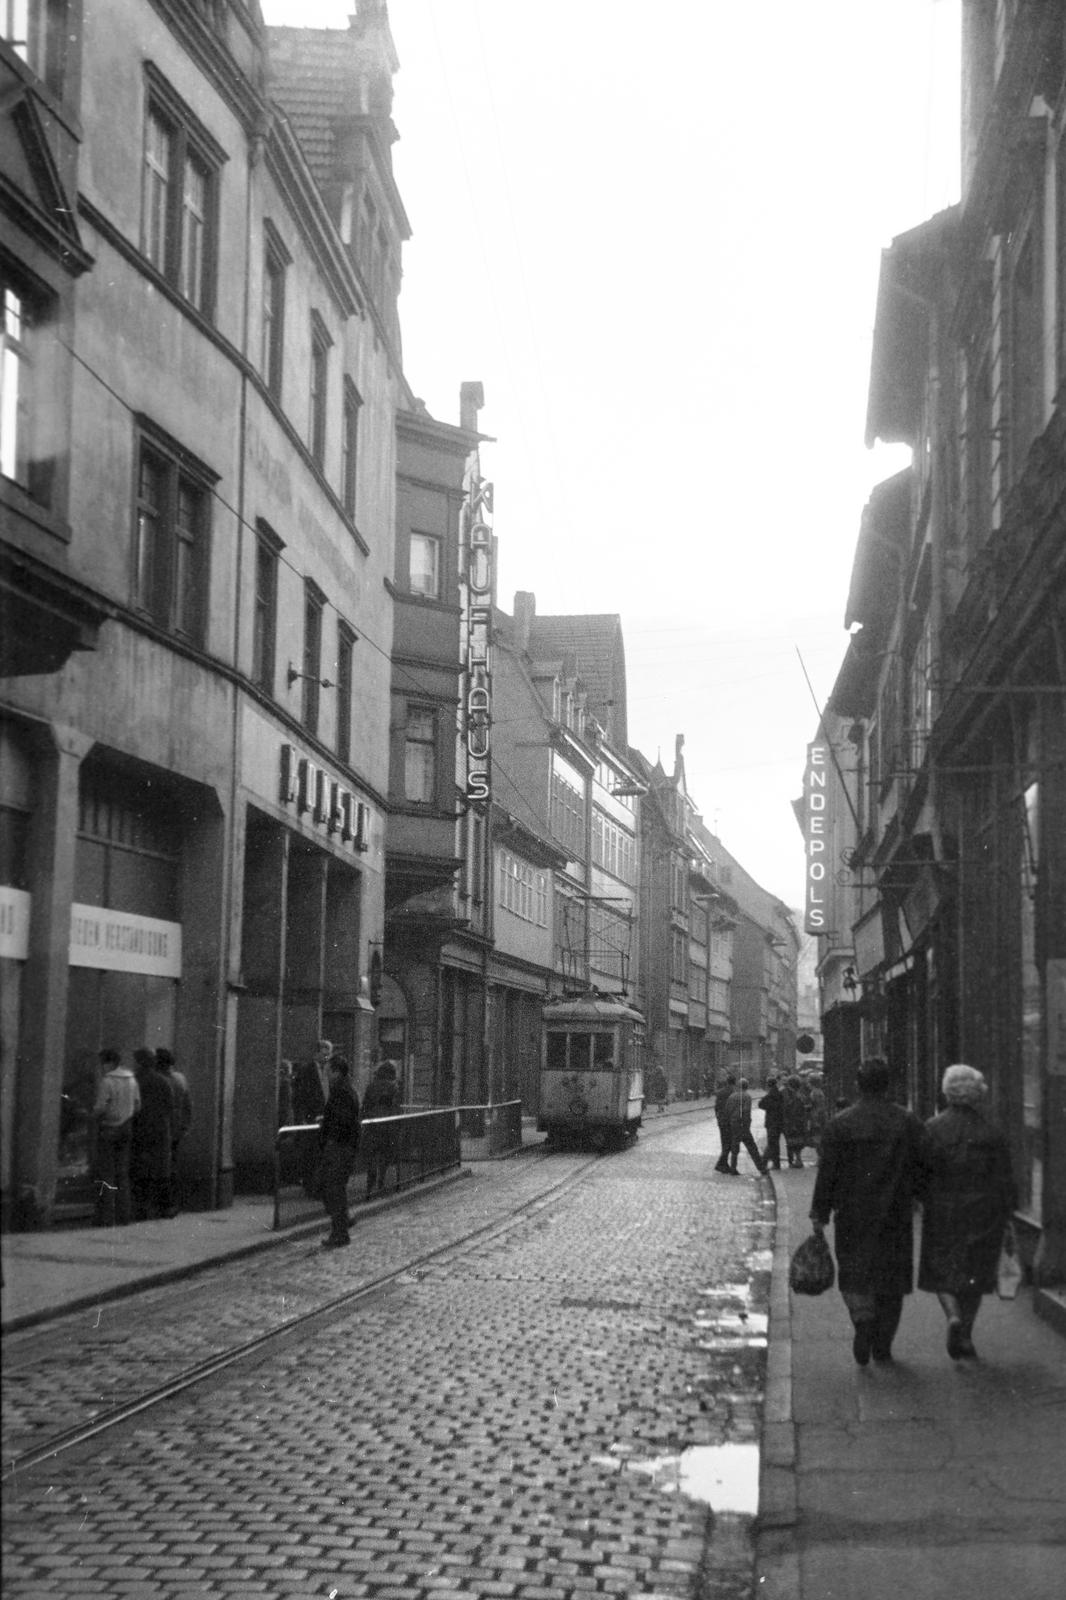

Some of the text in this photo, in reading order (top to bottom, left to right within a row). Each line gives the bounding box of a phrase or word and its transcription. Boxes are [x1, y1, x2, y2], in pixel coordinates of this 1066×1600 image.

[467, 482, 494, 799] KAUFHAUS
[280, 744, 371, 854] KONSUM
[809, 747, 826, 927] ENDEPOLS
